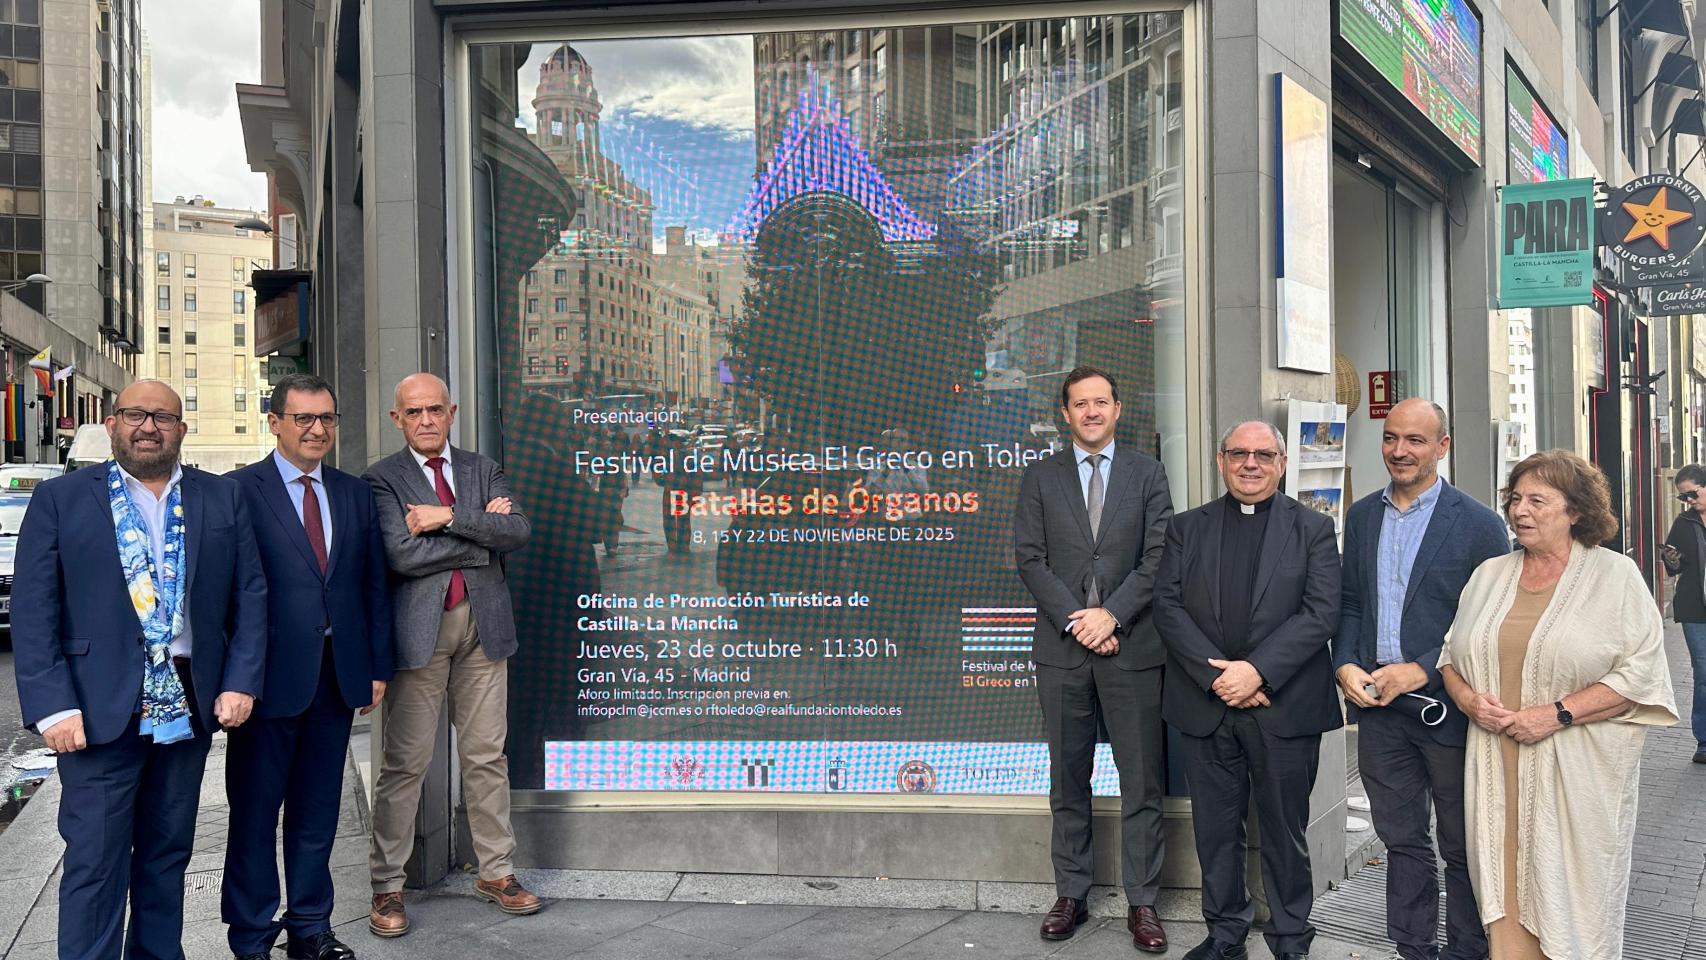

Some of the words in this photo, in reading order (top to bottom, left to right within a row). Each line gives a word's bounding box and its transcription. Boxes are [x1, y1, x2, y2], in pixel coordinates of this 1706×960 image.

[1625, 175, 1701, 203] CALIFORNIA
[1505, 197, 1589, 255] PARA
[1613, 244, 1676, 265] BURGERS
[1638, 272, 1658, 280] Gran
[1657, 288, 1690, 302] Carl's
[1662, 303, 1680, 311] Gran
[270, 365, 296, 375] ATM
[573, 405, 685, 425] Presentación:
[575, 448, 674, 475] Festival
[683, 447, 714, 473] de
[723, 446, 816, 474] Música
[824, 445, 847, 471] El
[856, 446, 933, 470] Greco
[941, 449, 974, 469] en
[980, 441, 1054, 469] Toled
[669, 487, 793, 517] Batallas
[802, 487, 839, 516] de
[848, 478, 980, 522] Órganos
[692, 528, 707, 545] 8,
[711, 530, 730, 543] 15
[731, 530, 744, 543] Y
[747, 529, 765, 543] 22
[769, 529, 790, 543] DE
[793, 528, 886, 542] NOVIEMBRE
[890, 527, 912, 541] DE
[914, 527, 955, 541] 2025
[577, 593, 638, 609] Oficina
[643, 593, 664, 609] de
[670, 591, 765, 608] Promoción
[769, 591, 843, 608] Turística
[847, 591, 870, 607] de
[577, 616, 665, 632] Castilla-La
[671, 615, 738, 631] Mancha
[576, 640, 650, 662] Jueves,
[656, 639, 681, 659] 23
[688, 638, 714, 658] de
[722, 638, 802, 658] octubre
[822, 638, 879, 658] 11:30
[885, 637, 897, 657] h
[962, 659, 1008, 672] Festival
[1010, 660, 1025, 672] de
[577, 668, 616, 683] Gran
[621, 668, 650, 685] Vía,
[655, 668, 675, 683] 45
[692, 667, 751, 683] Madrid
[962, 675, 974, 687] El
[976, 675, 1011, 687] Greco
[1014, 678, 1028, 687] en
[577, 688, 611, 700] Aforo
[613, 688, 664, 700] limitado.
[667, 687, 730, 702] Inscripción
[734, 688, 770, 702] previa
[771, 689, 791, 700] en:
[577, 703, 692, 719] infoopclm@jccm.es
[694, 707, 703, 716] o
